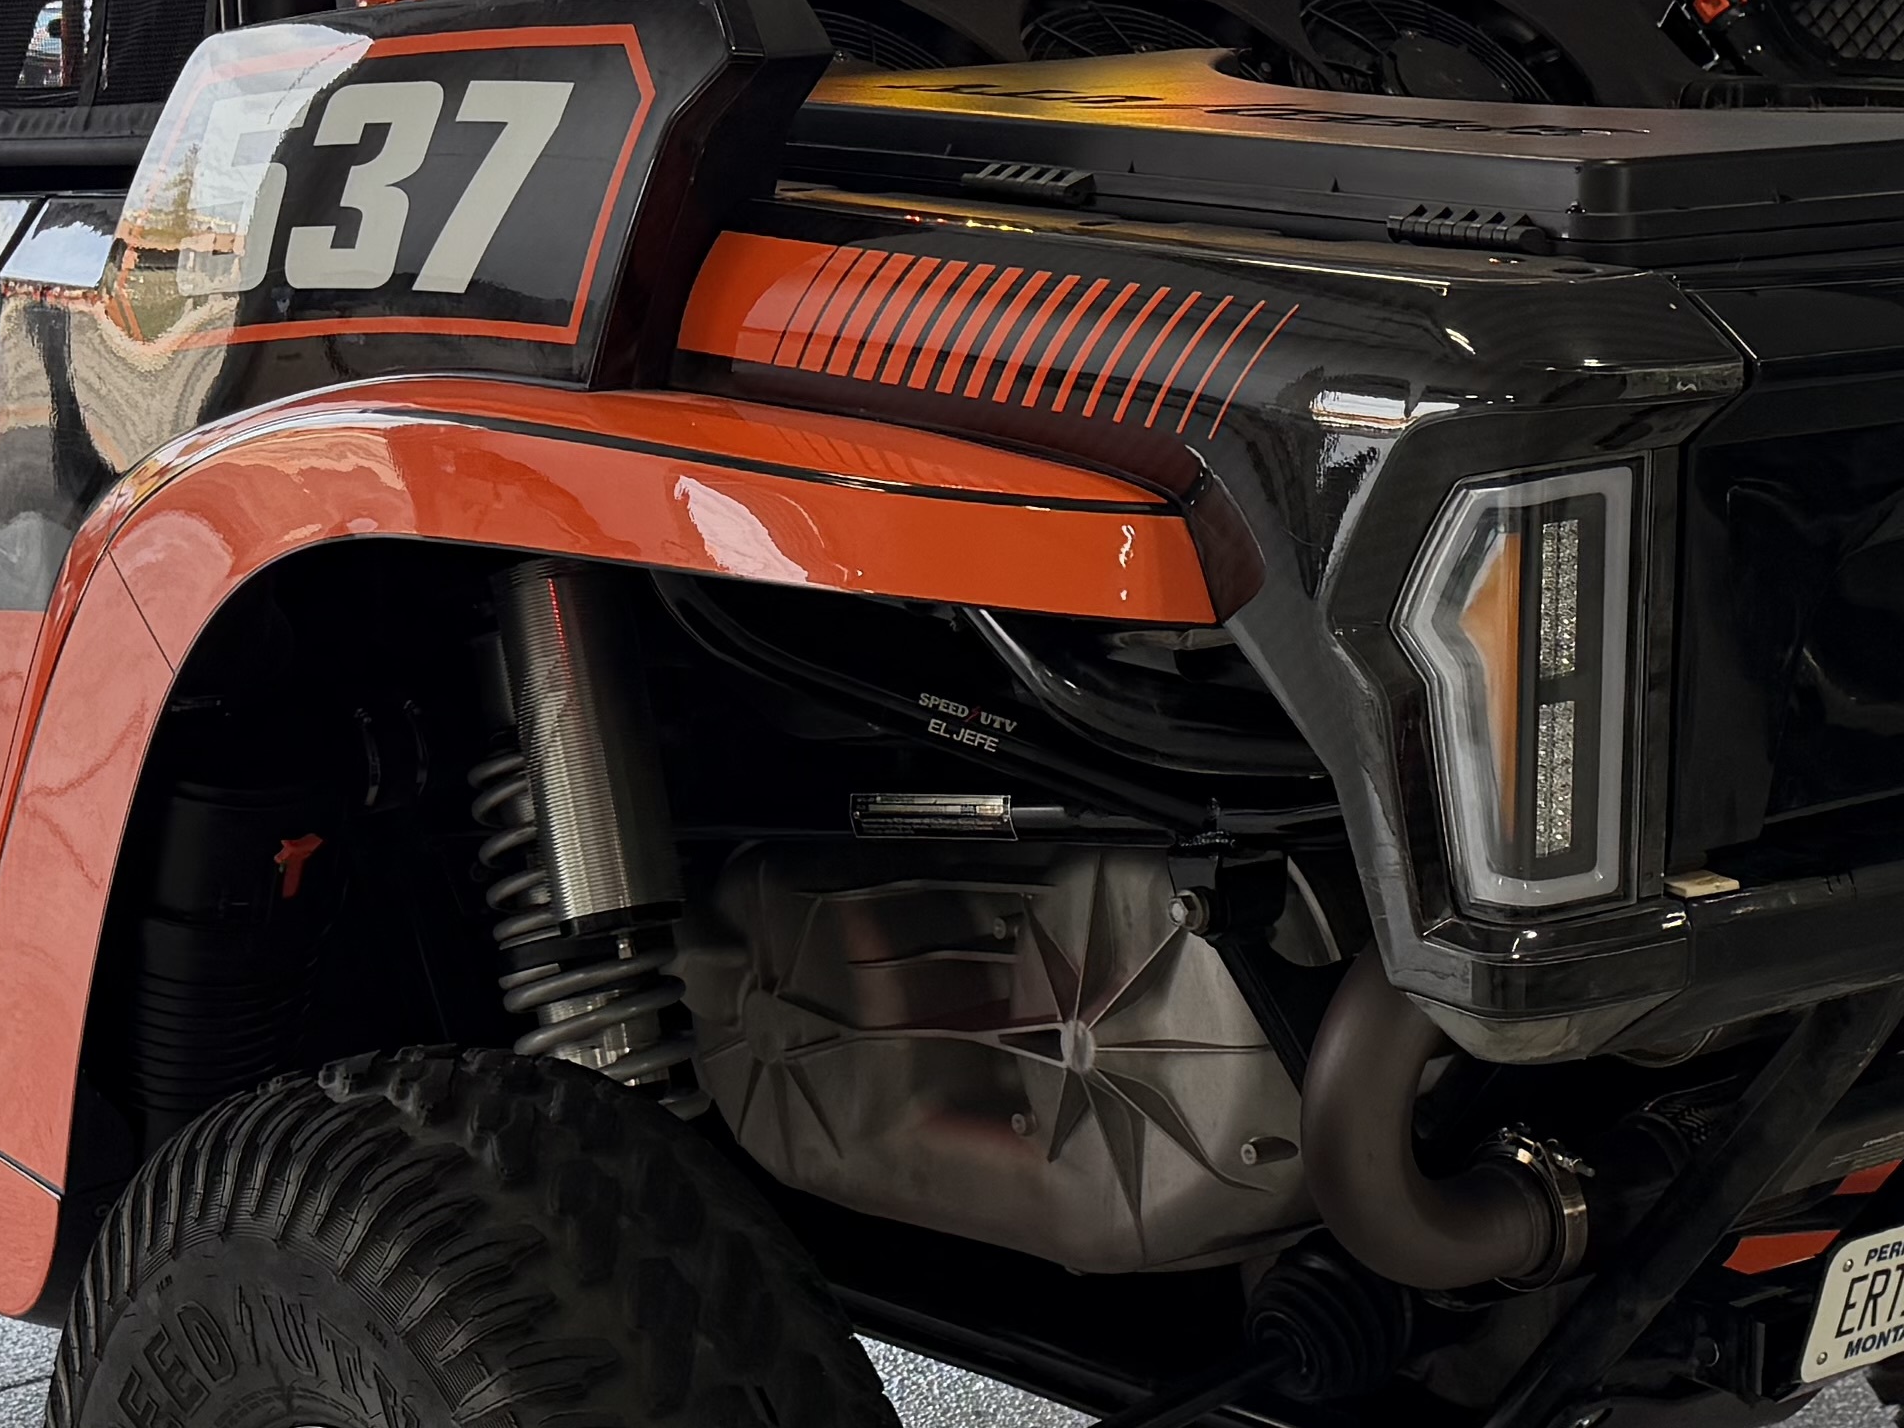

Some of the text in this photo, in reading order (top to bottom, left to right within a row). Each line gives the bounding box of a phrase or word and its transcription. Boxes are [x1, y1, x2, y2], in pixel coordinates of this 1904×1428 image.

[177, 78, 574, 300] 537
[918, 693, 1018, 733] SPEED UTV
[928, 718, 999, 752] EL JEFE
